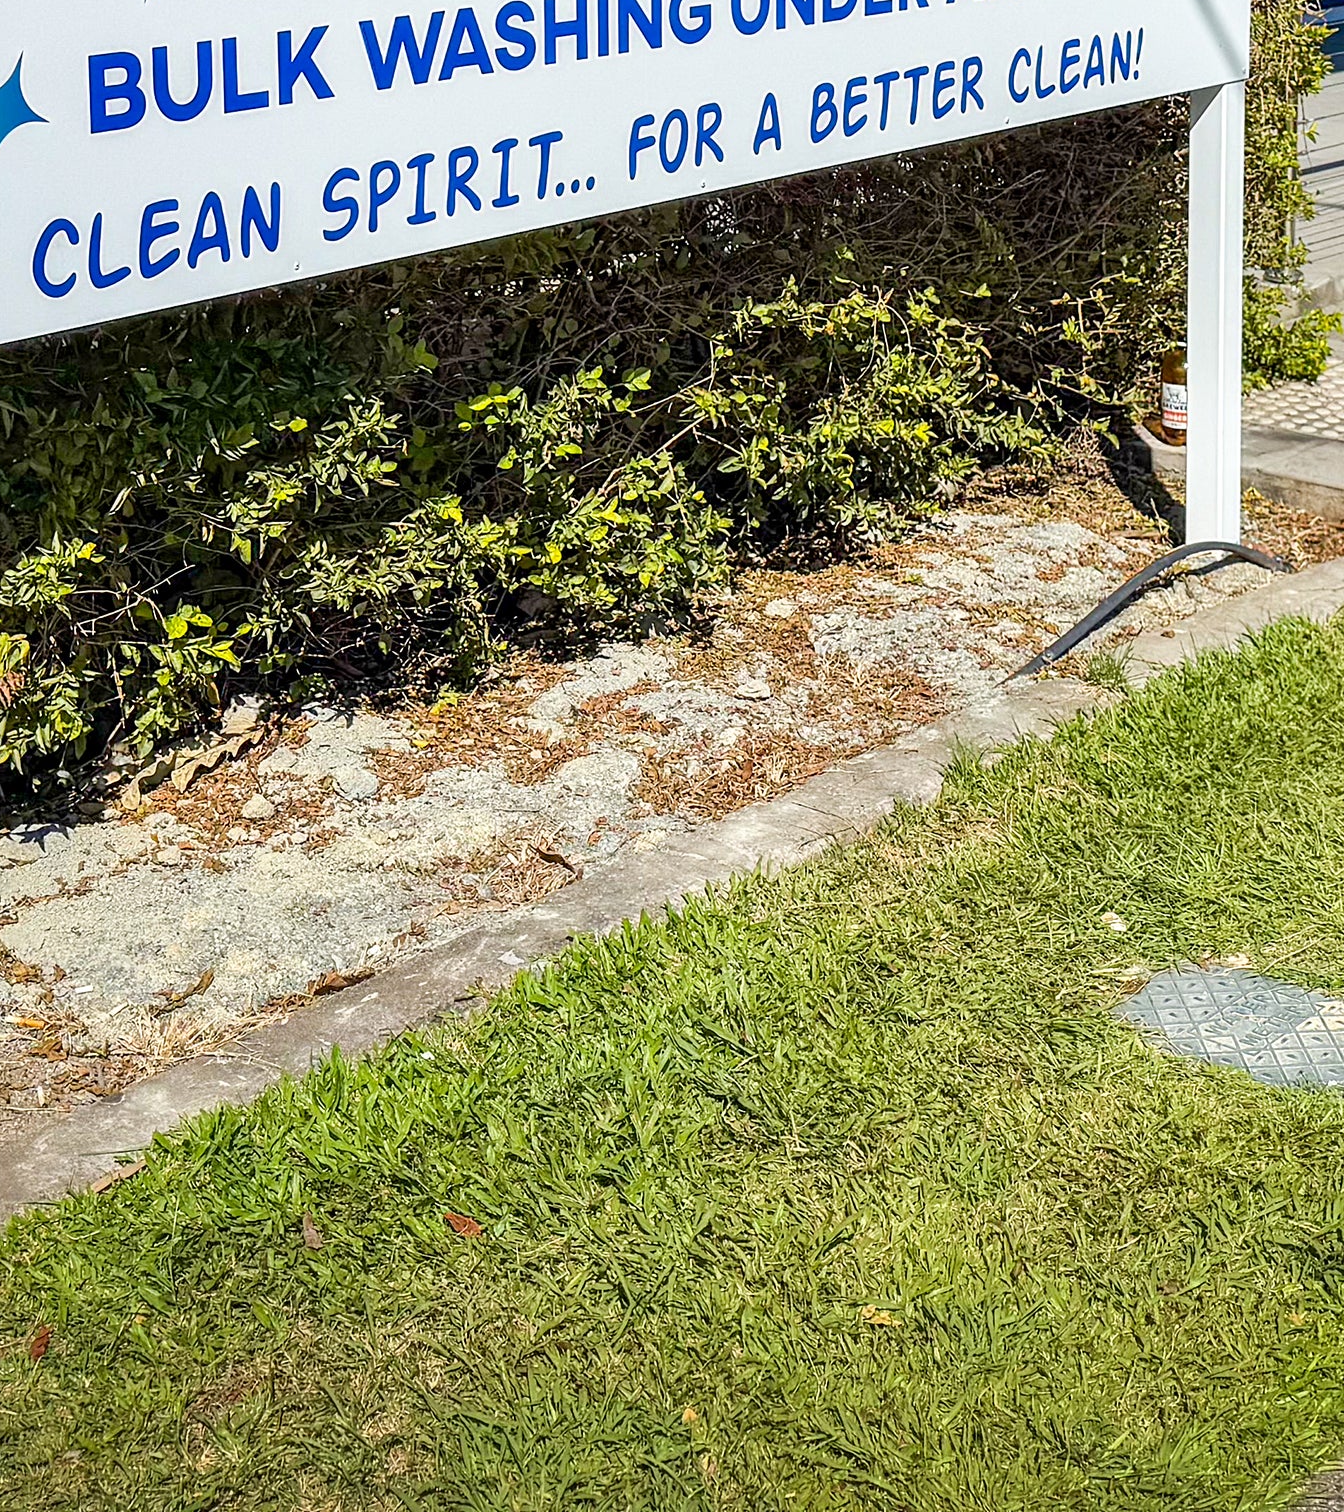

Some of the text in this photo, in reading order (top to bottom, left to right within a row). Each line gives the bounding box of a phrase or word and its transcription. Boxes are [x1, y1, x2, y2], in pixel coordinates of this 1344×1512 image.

[32, 29, 1144, 299] CLEAN SPIRIT... FOR A BETTER CLEAN!
[87, 25, 336, 134] BULK
